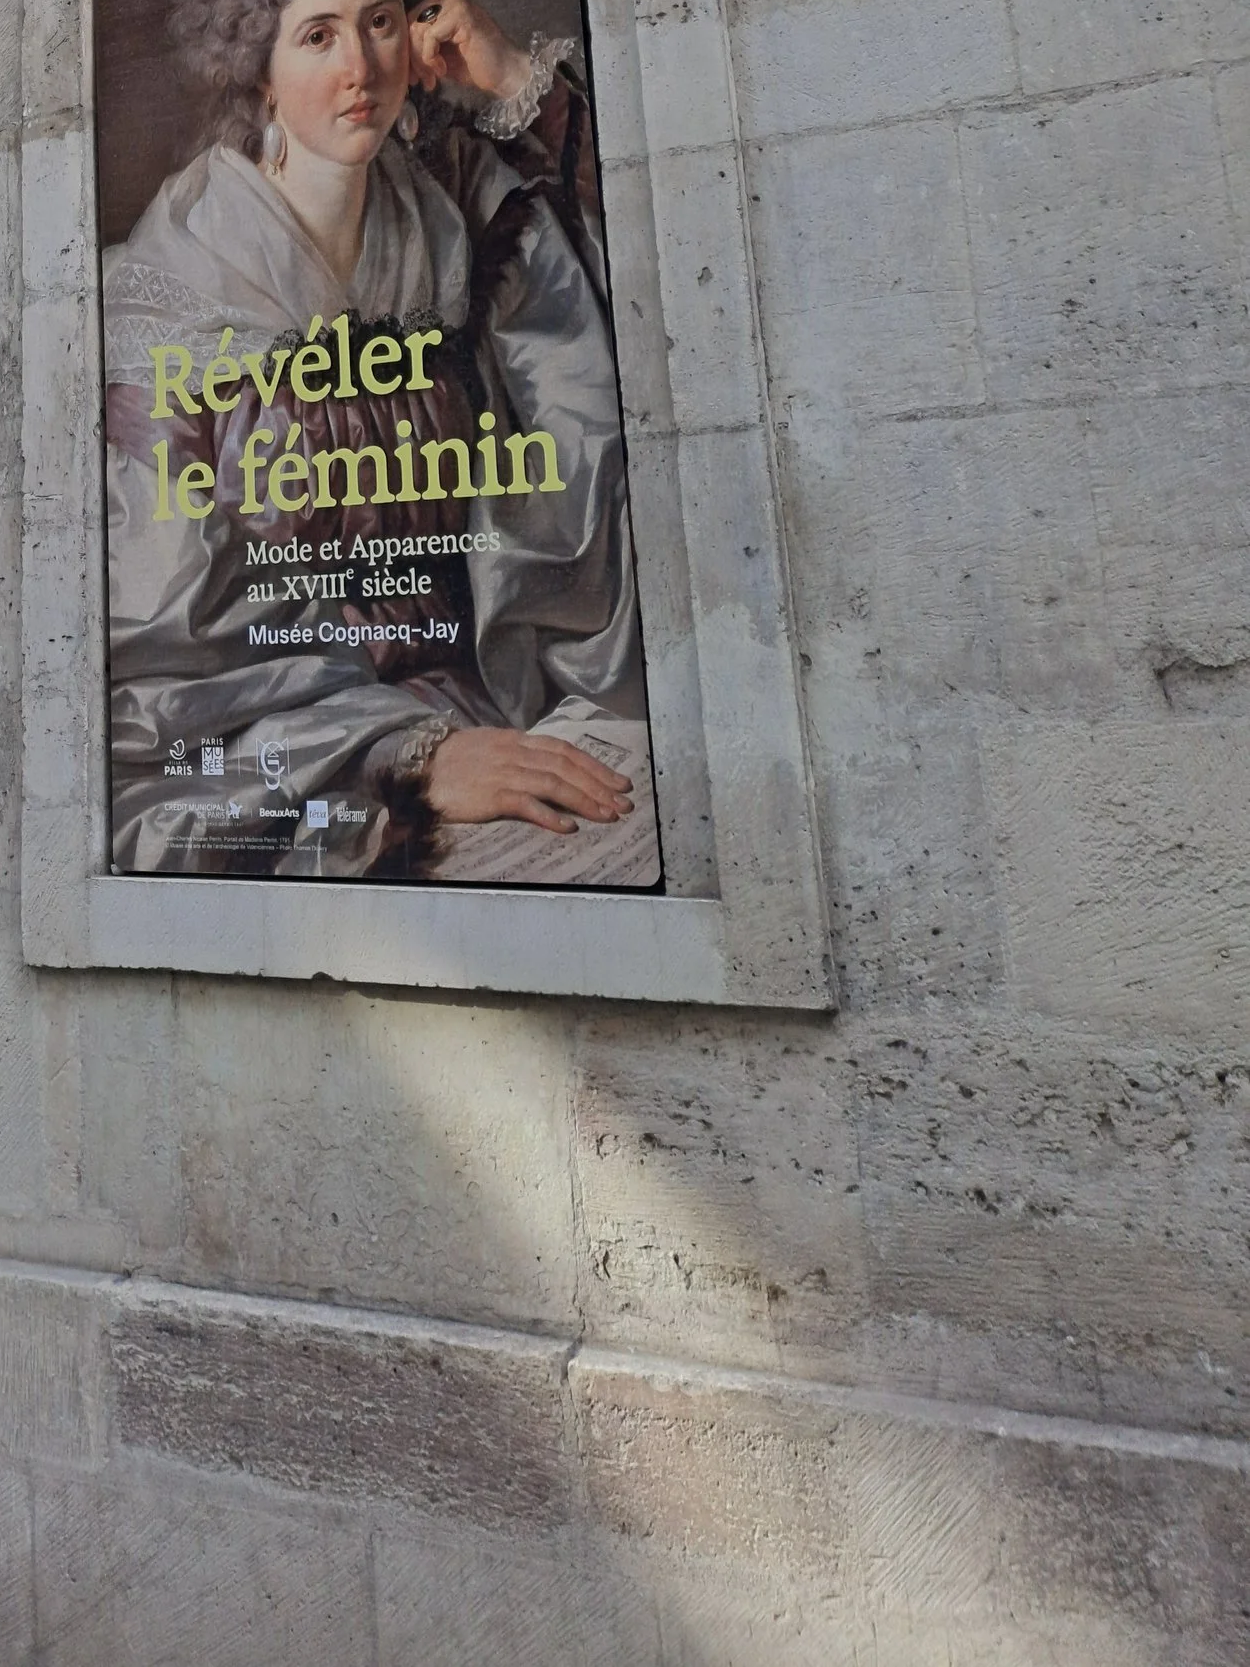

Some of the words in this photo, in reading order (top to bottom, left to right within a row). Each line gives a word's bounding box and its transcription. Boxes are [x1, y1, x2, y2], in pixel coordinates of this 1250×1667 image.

[150, 313, 443, 419] Révéler
[152, 439, 216, 521] le
[238, 411, 566, 514] féminin
[245, 536, 313, 565] Mode
[319, 539, 343, 561] et
[348, 531, 501, 566] Apparences
[247, 583, 275, 603] au
[362, 567, 432, 598] siècle
[249, 623, 313, 645] Musée
[318, 618, 460, 647] Cognacq-Jay
[201, 737, 224, 746] PARIS
[164, 765, 193, 776] PARIS
[189, 803, 225, 812] MUNICIPAL
[197, 811, 206, 819] DE
[207, 811, 225, 819] PARIS
[259, 807, 300, 818] BeauxArts
